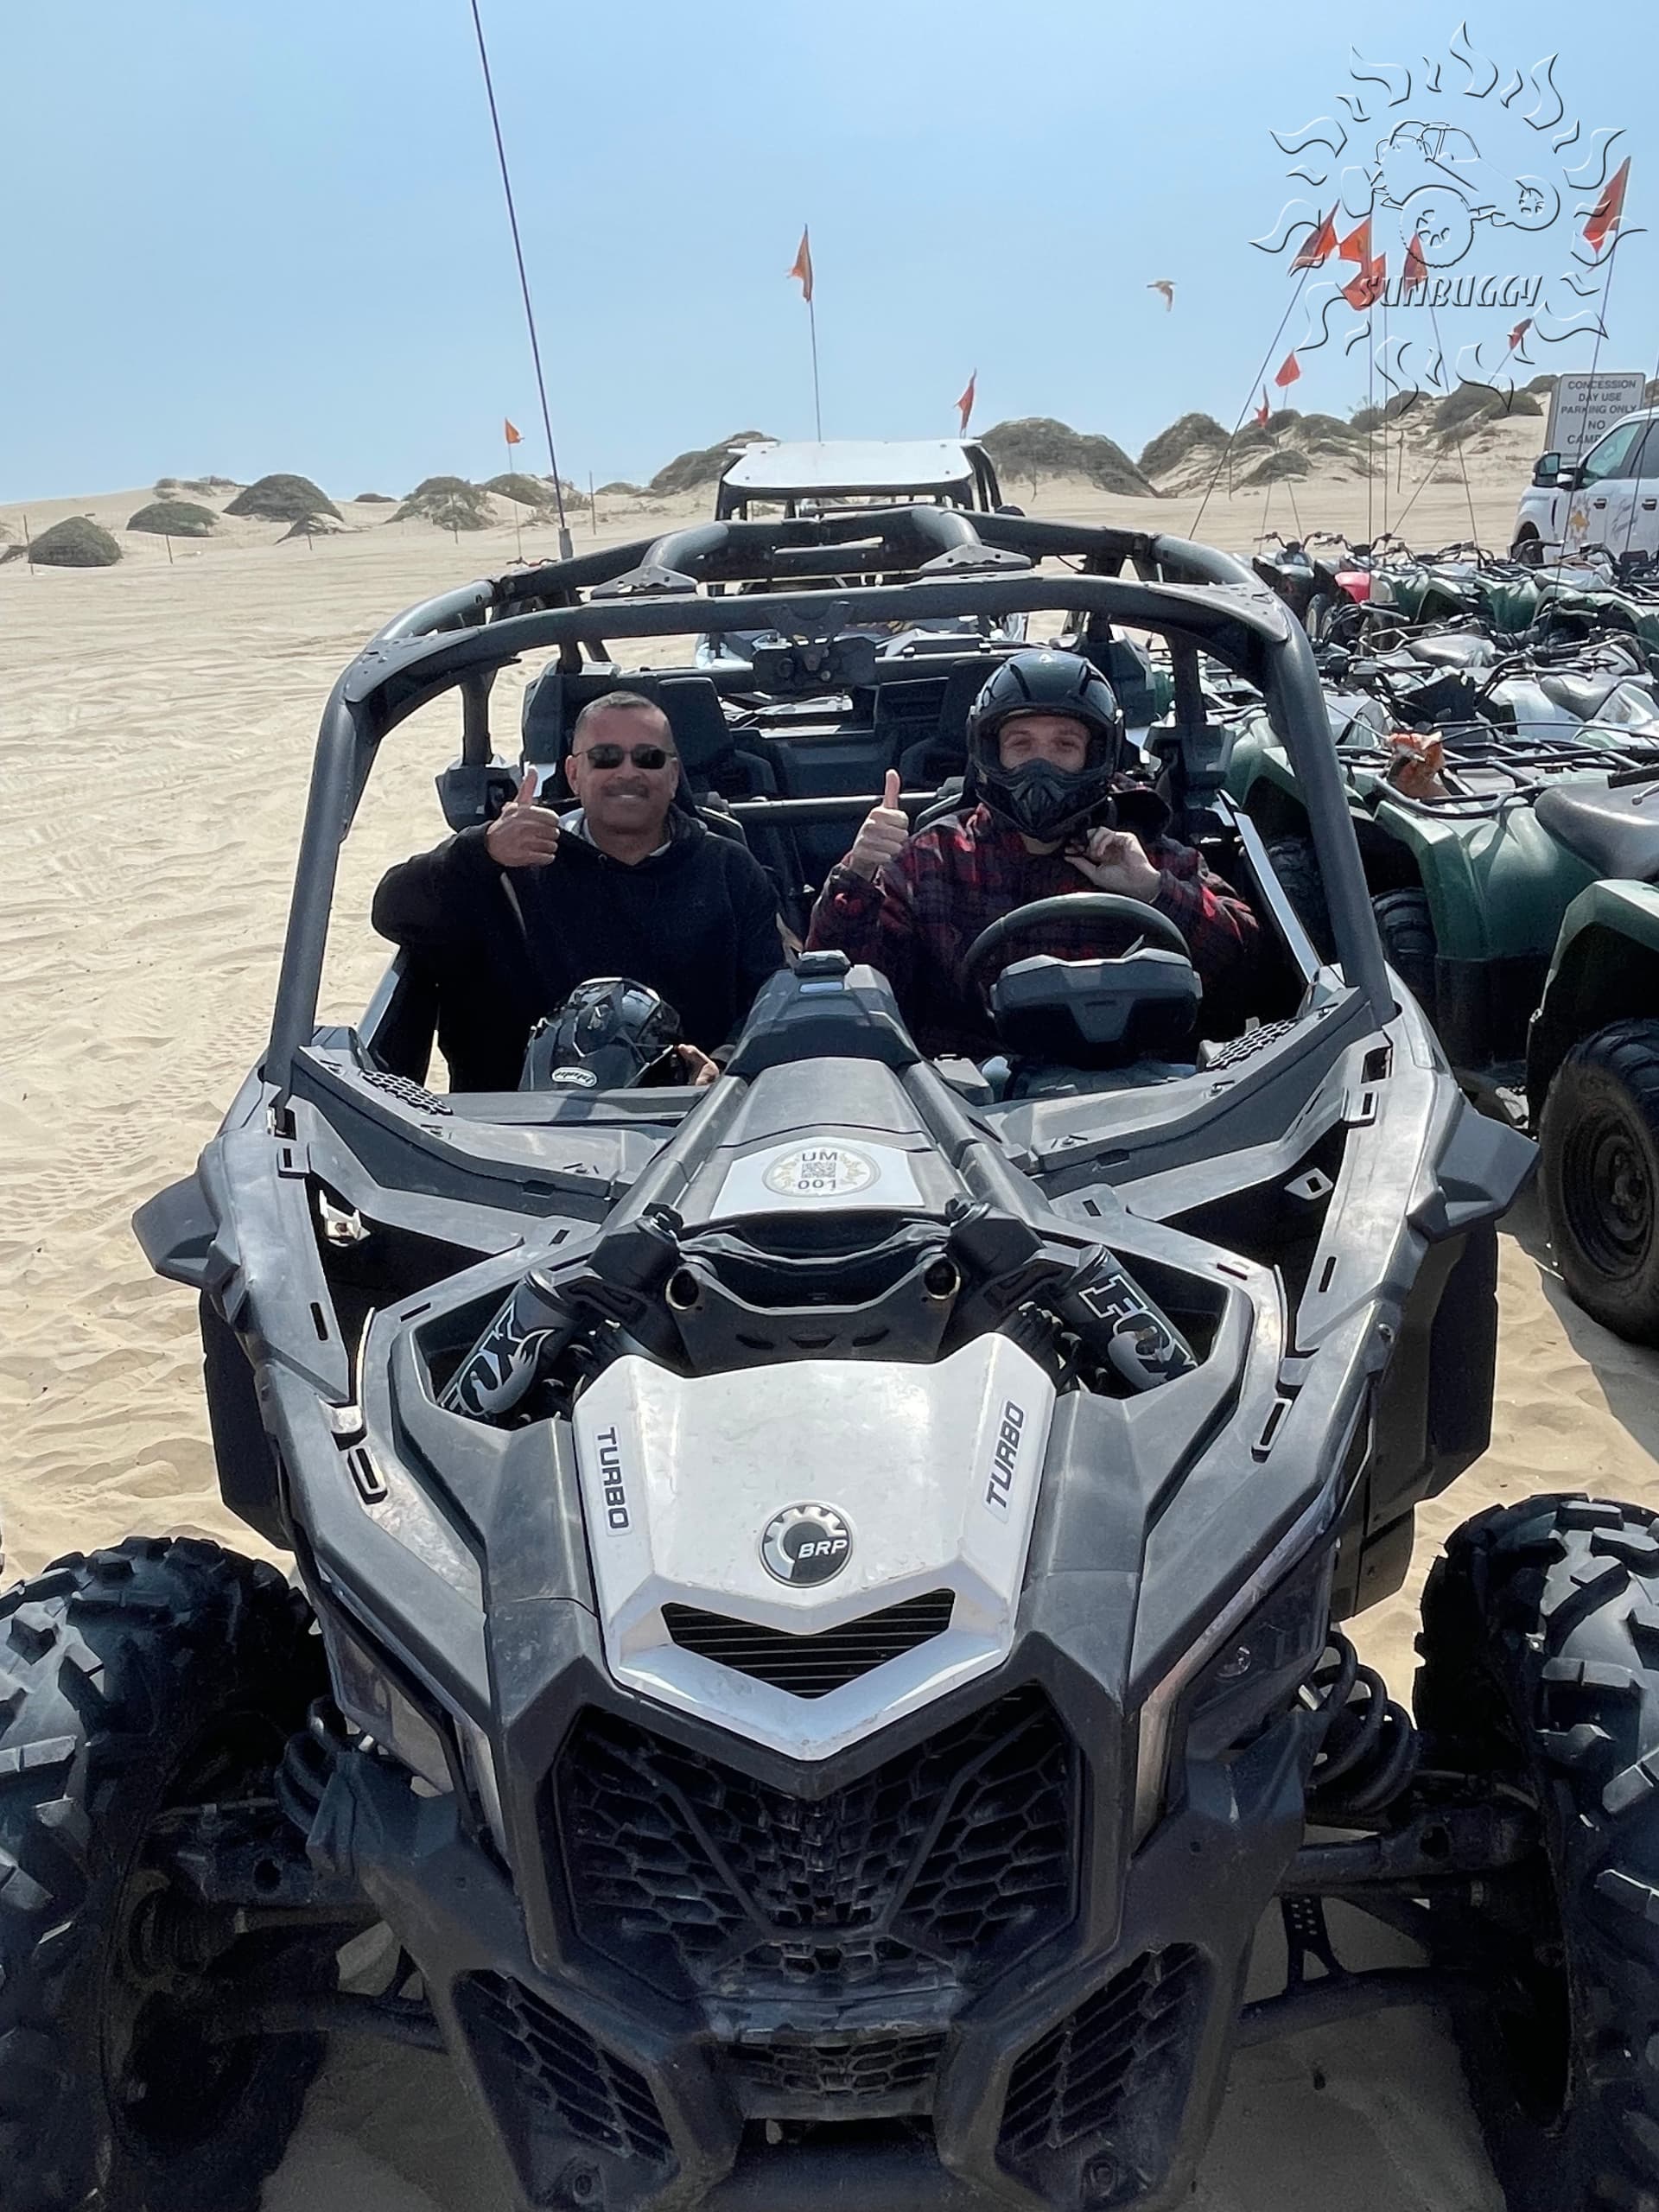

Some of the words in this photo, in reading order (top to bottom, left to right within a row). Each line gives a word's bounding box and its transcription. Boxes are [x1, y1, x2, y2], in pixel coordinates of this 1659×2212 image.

[1567, 380, 1636, 390] CONCESSION
[1578, 393, 1599, 402] DAY
[1601, 392, 1622, 402] USE
[1609, 404, 1637, 414] ONLY
[1587, 420, 1605, 430] NO
[1567, 434, 1602, 444] CAMP
[801, 1151, 838, 1162] UM
[798, 1179, 837, 1190] 001
[986, 1400, 1025, 1509] TURBO
[597, 1427, 629, 1529] TURBO
[798, 1539, 848, 1559] BRP
